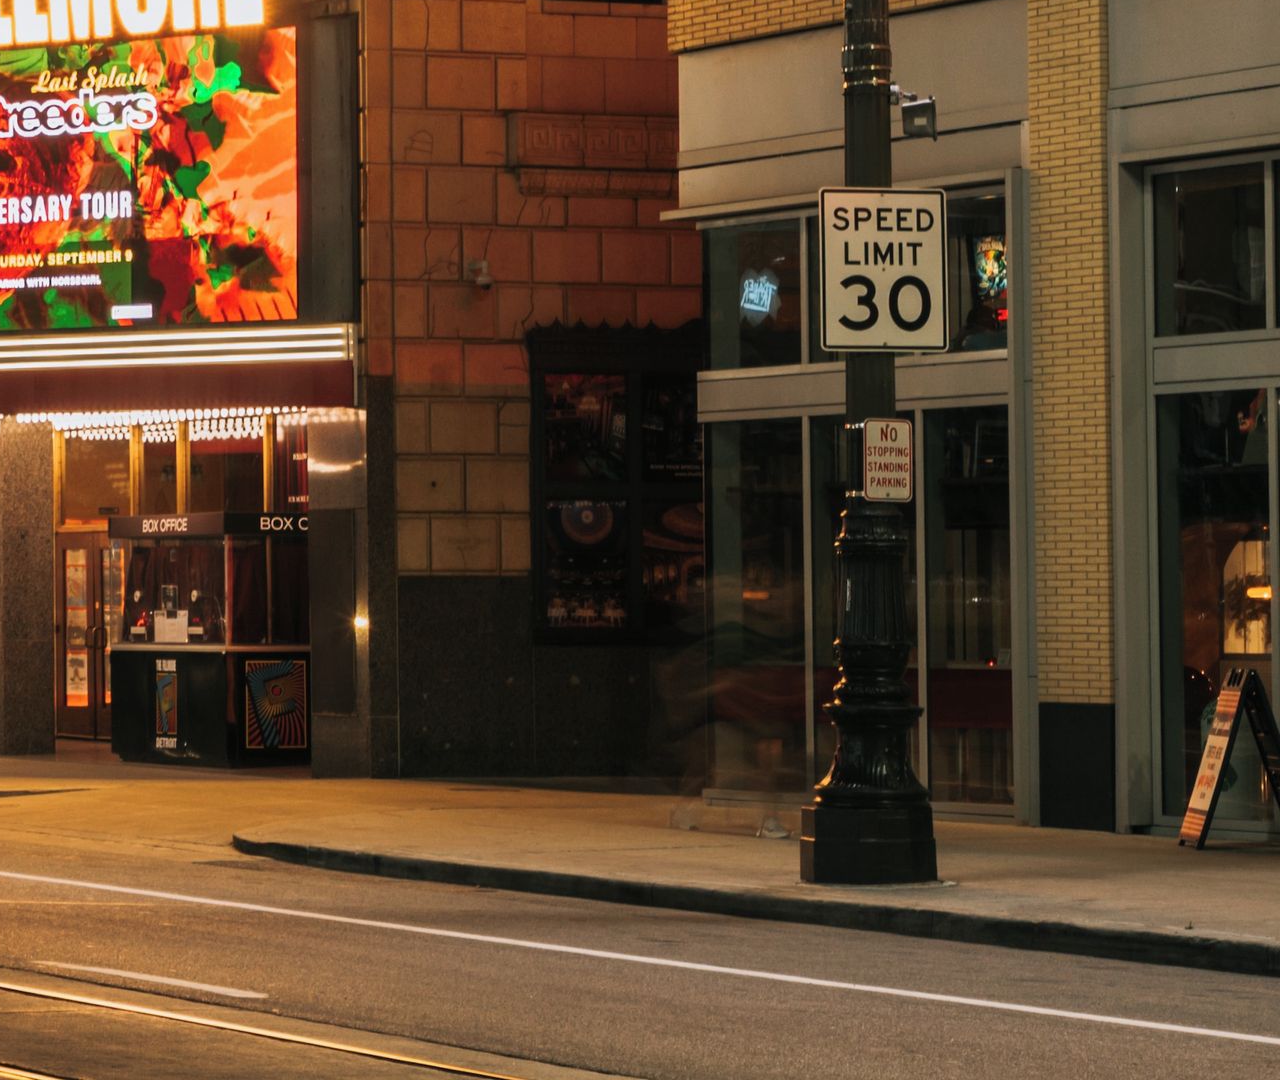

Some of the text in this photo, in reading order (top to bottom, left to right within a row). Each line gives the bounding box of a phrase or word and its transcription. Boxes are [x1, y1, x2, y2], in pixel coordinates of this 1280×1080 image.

[31, 63, 149, 94] Last Splash
[79, 190, 133, 221] TOUR
[832, 206, 935, 232] SPEED
[47, 250, 122, 267] SEPTEMBER
[124, 248, 133, 263] 9
[844, 241, 923, 266] LIMIT
[838, 274, 932, 332] 30
[880, 426, 898, 442] NO
[867, 446, 909, 457] STOPPING
[867, 461, 909, 473] STANDING
[870, 476, 907, 488] PARKING
[142, 518, 188, 533] BOX OFFICE
[260, 517, 294, 531] BOX
